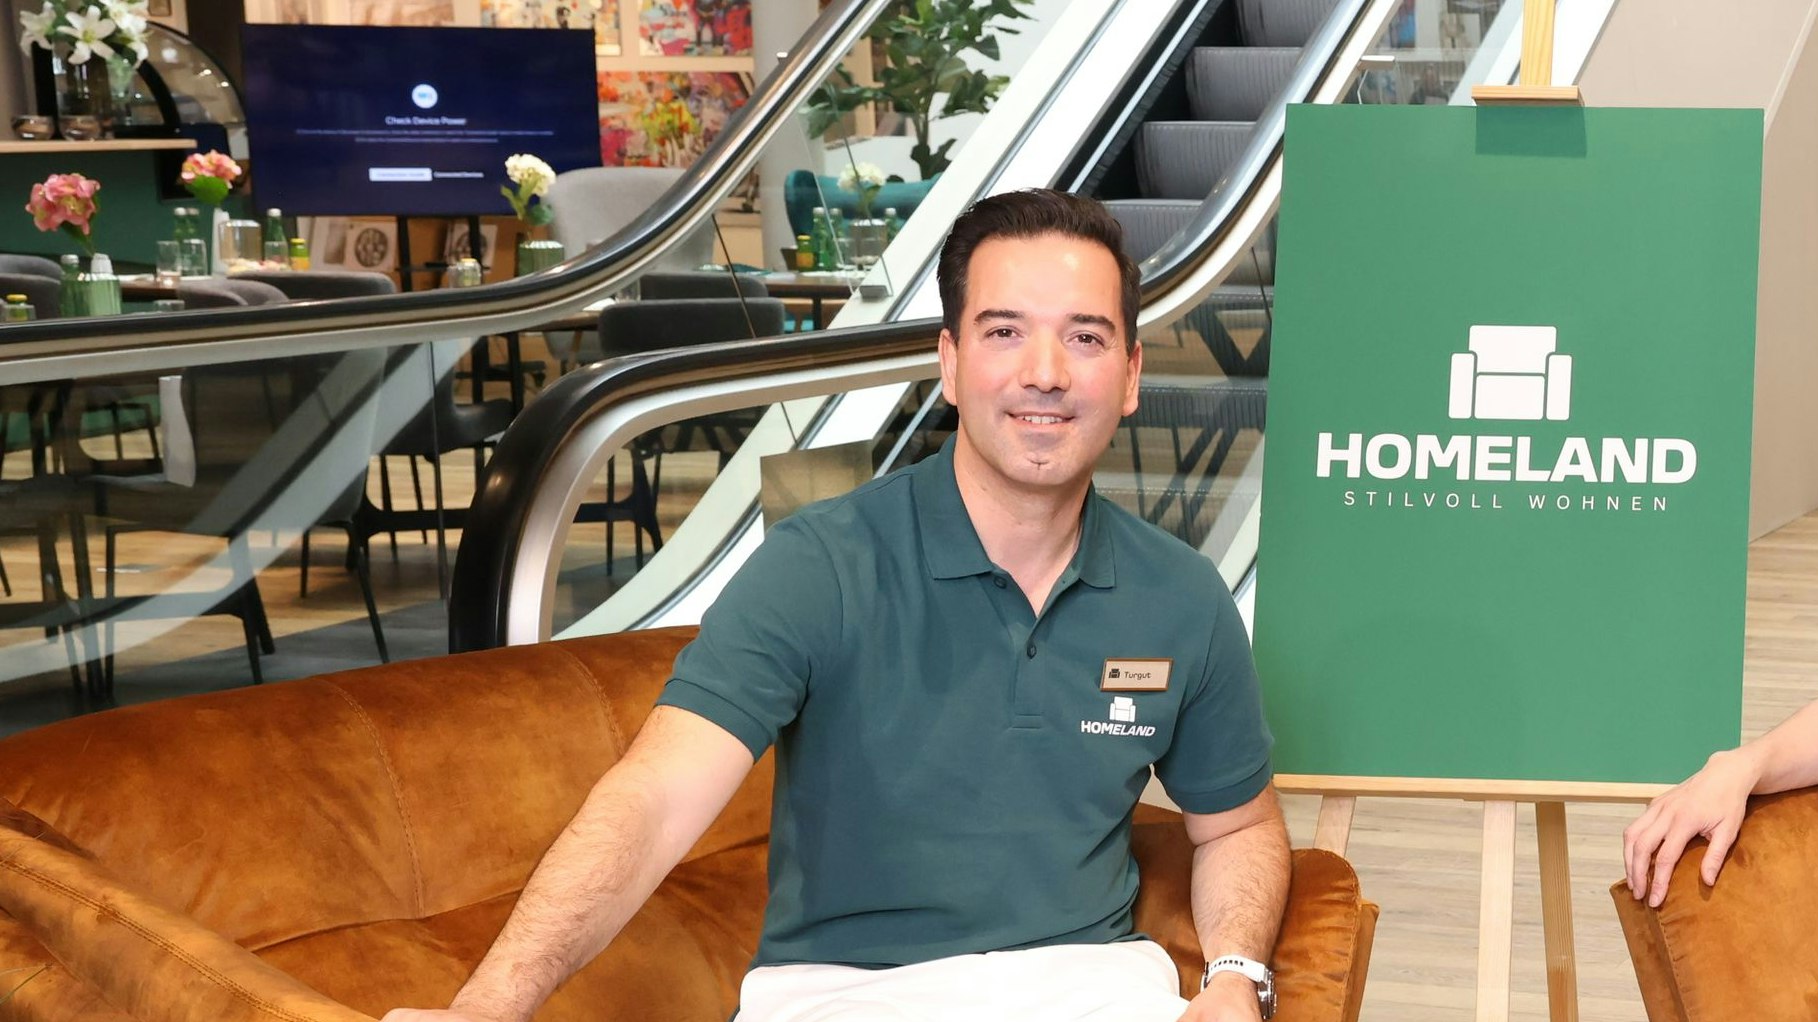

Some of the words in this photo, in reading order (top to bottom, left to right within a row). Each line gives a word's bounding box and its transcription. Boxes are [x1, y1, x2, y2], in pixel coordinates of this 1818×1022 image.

[385, 116, 411, 125] Check
[1316, 432, 1698, 484] HOMELAND
[1344, 491, 1502, 509] STILVOLL
[1529, 495, 1667, 511] WOHNEN
[1124, 671, 1151, 680] Turgut
[1081, 720, 1156, 737] HOMELAND
